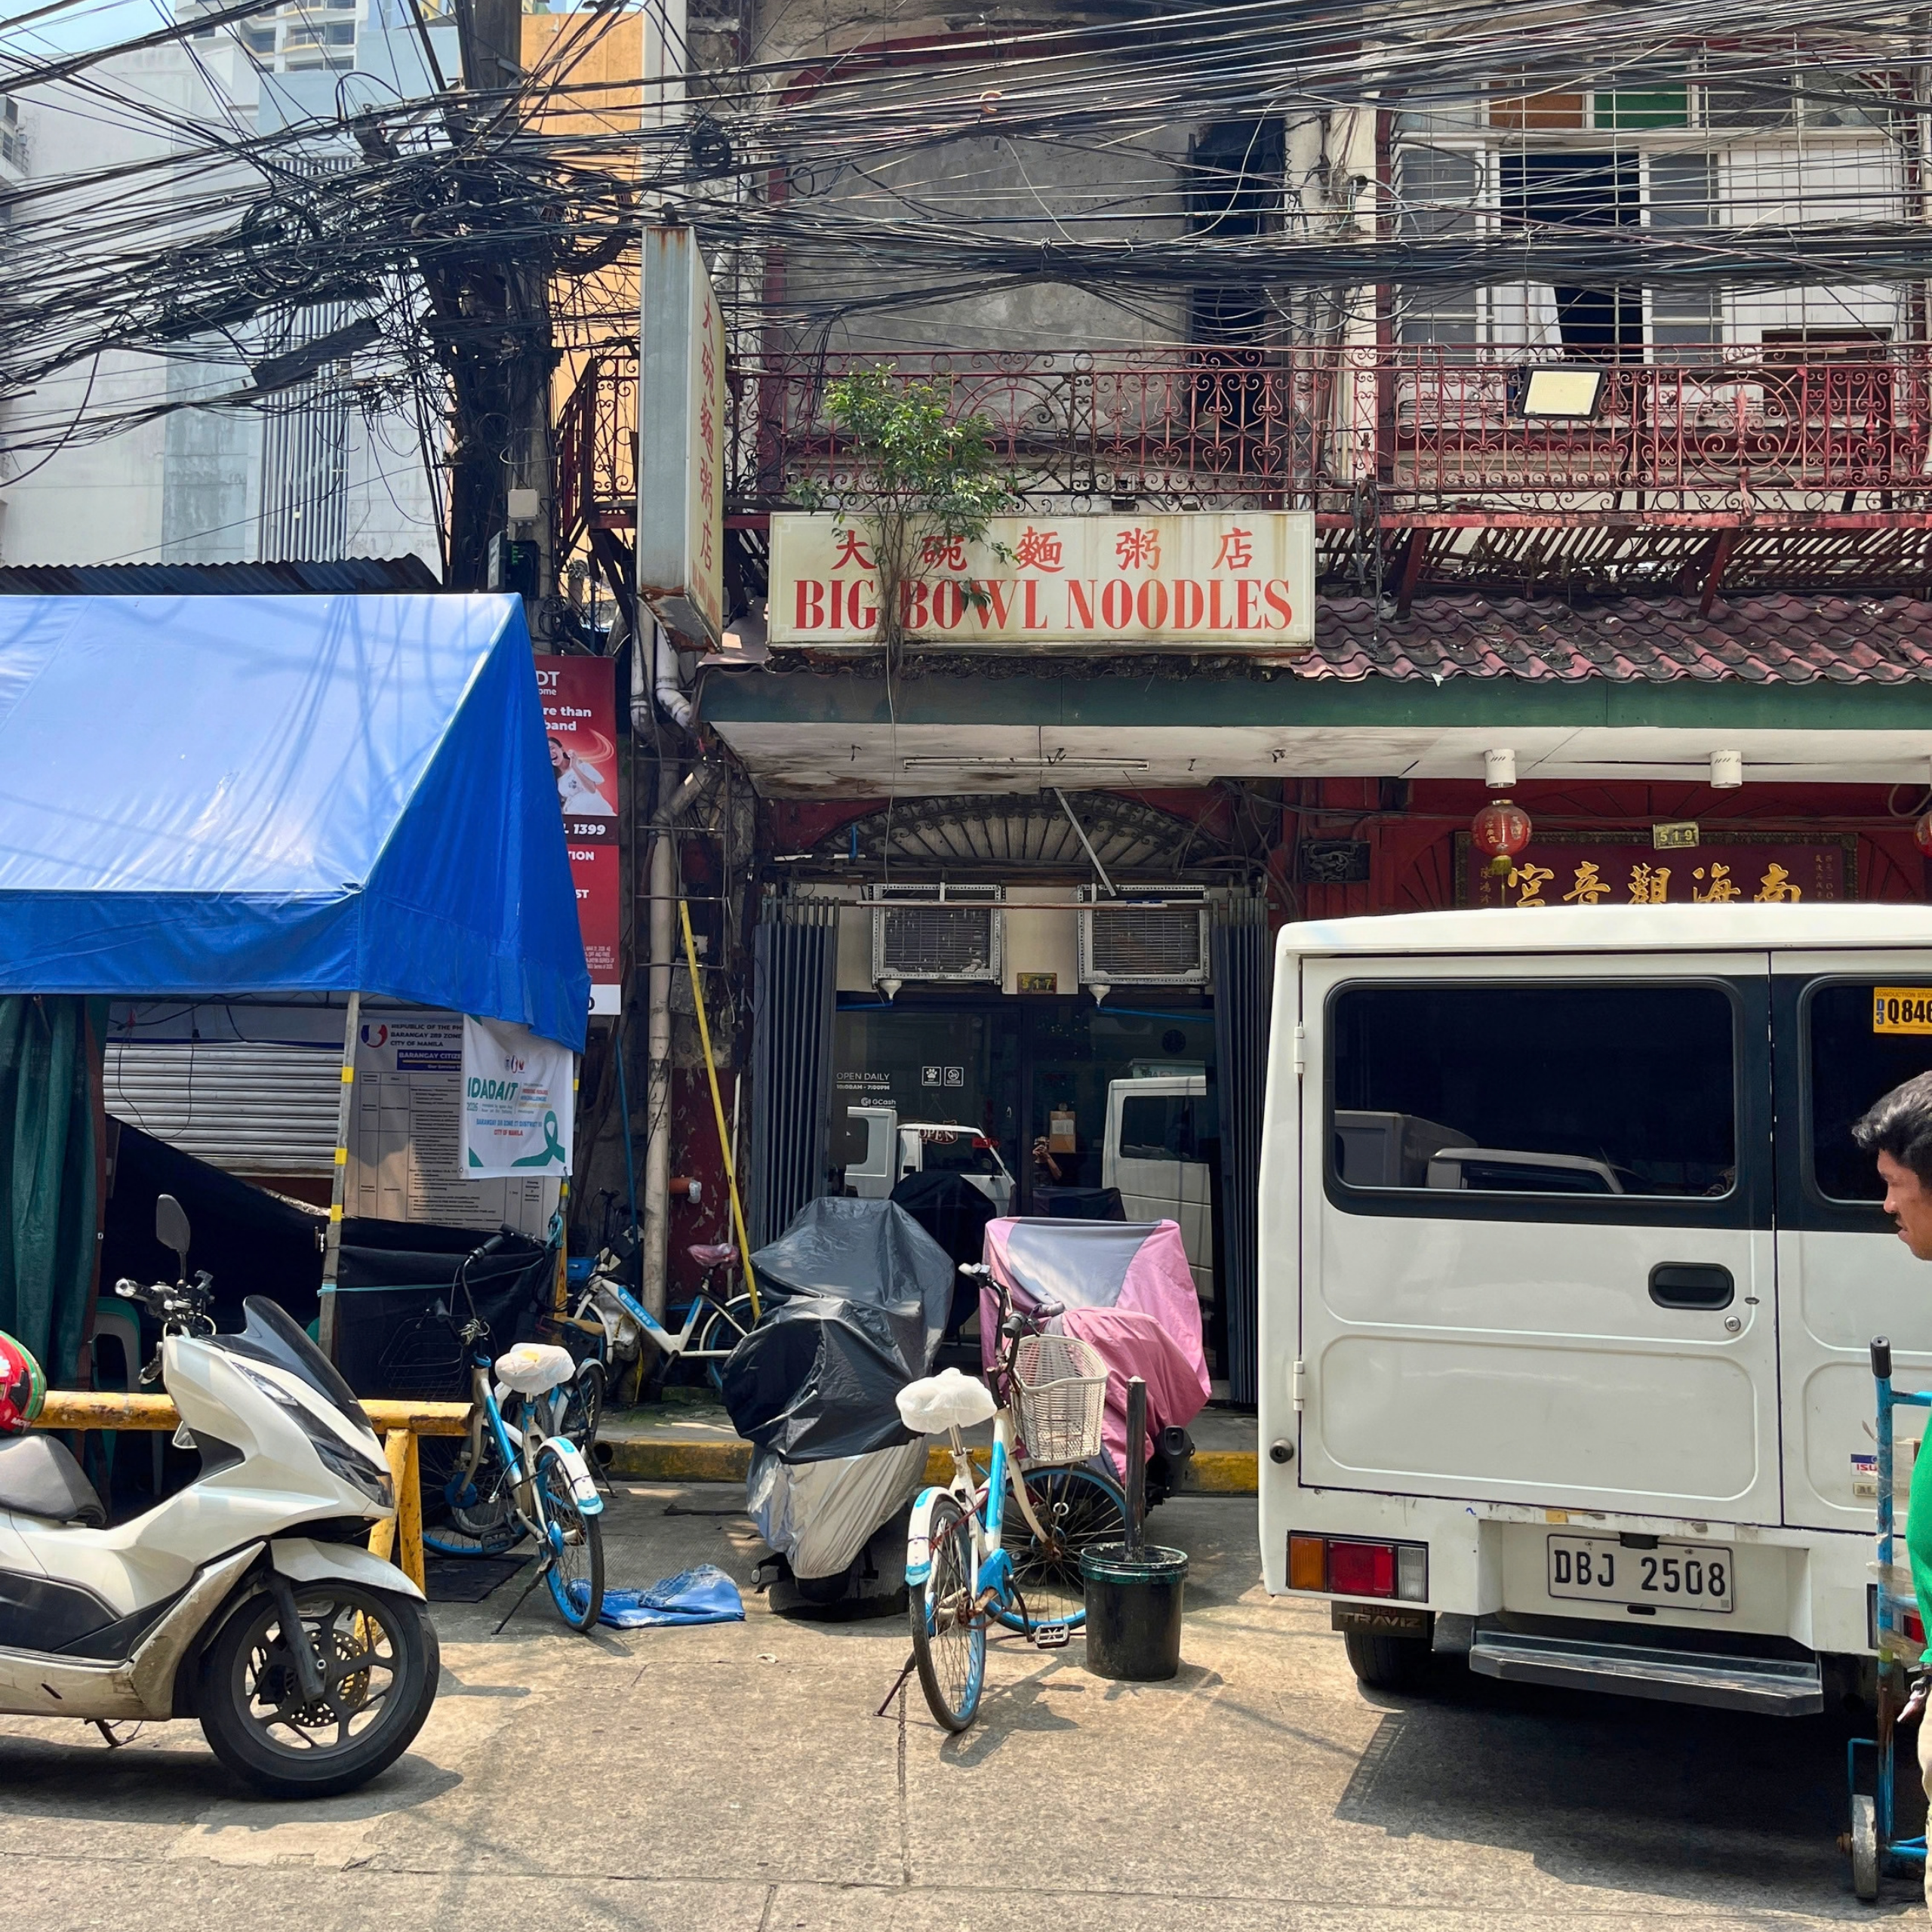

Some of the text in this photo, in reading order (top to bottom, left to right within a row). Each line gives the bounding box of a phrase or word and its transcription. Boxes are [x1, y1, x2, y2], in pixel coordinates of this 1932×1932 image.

[830, 526, 1253, 574] 大碗麵粥店
[792, 579, 1292, 630] BIG BOWL NOODLES
[561, 706, 592, 717] than
[574, 823, 606, 835] 1399
[1660, 829, 1694, 842] 519
[1022, 978, 1052, 989] 517
[467, 1076, 518, 1101] IDADAIT
[919, 1129, 954, 1142] OPEN
[1554, 1549, 1726, 1597] DBJ 2508
[1337, 1611, 1422, 1629] TRAVIZ
